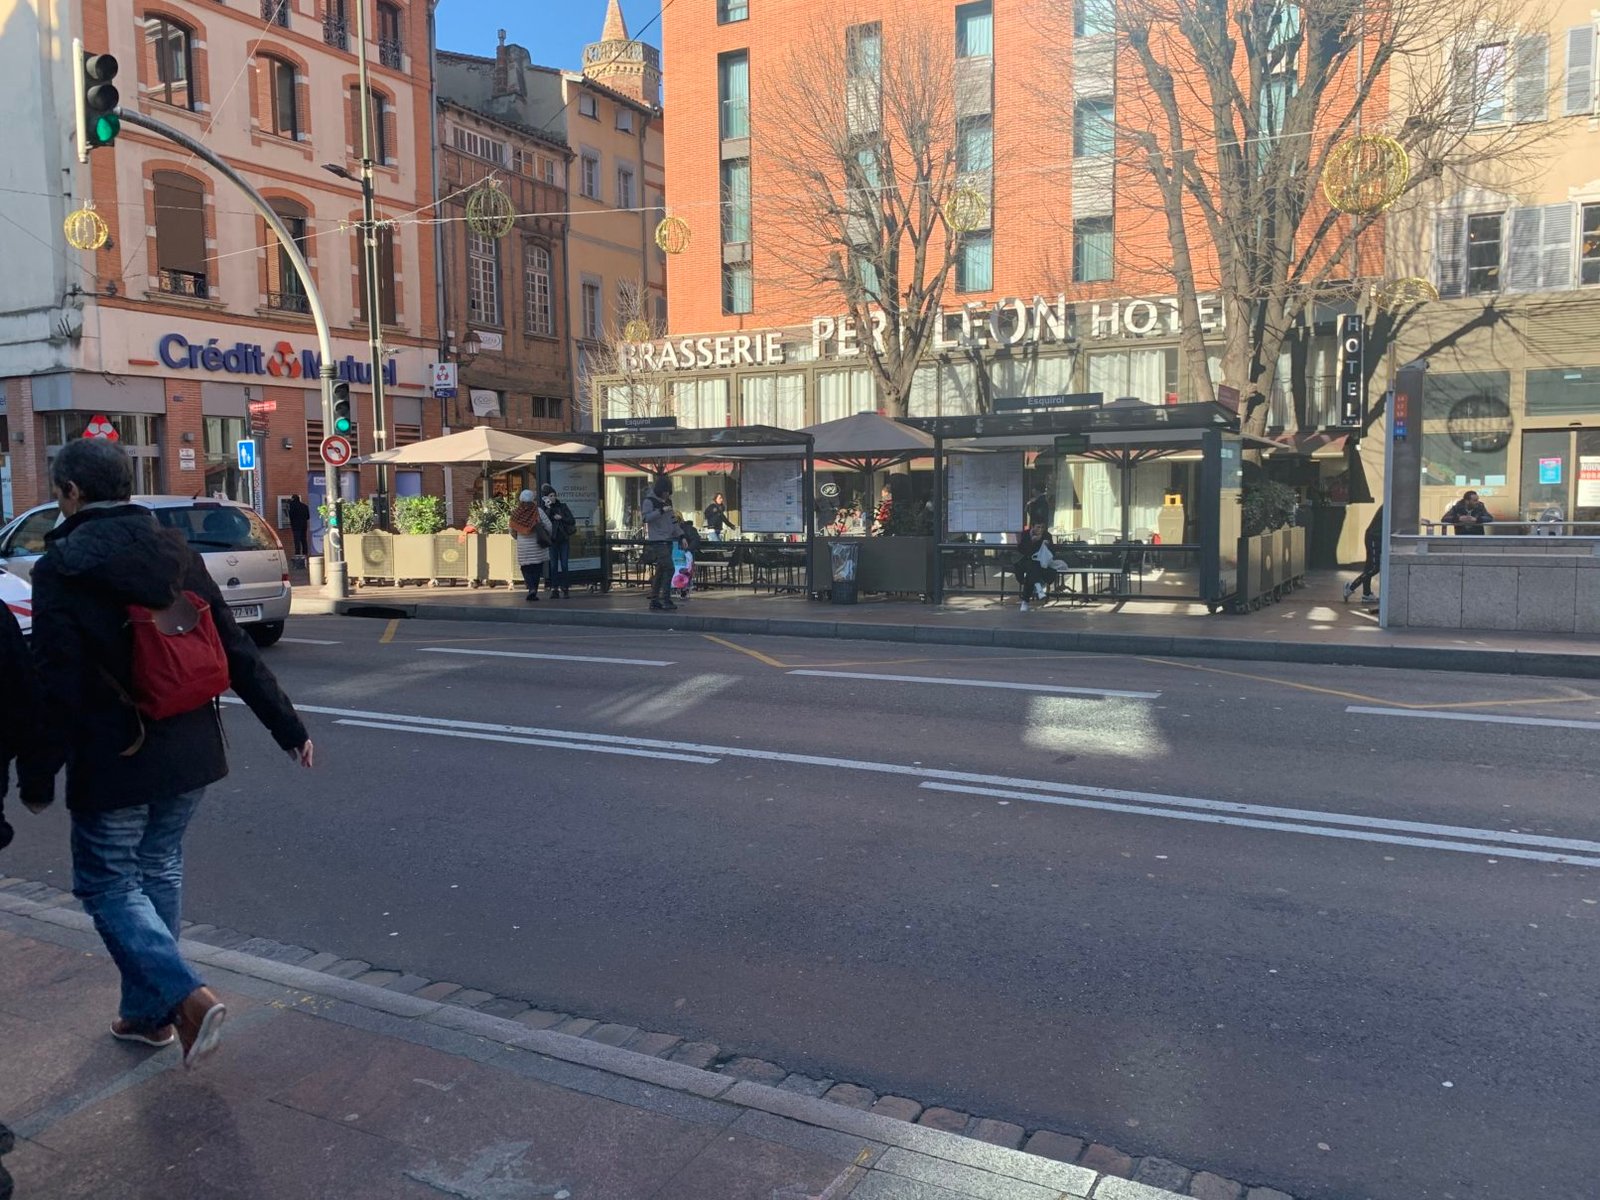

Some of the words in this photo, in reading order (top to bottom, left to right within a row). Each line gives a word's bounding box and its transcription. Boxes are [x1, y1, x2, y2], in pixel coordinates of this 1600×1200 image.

[159, 333, 266, 375] Crédit
[620, 332, 784, 372] BRASSERIE
[1345, 316, 1360, 417] HOTEL
[1027, 395, 1065, 406] Esquirol
[624, 418, 651, 427] Esquirol
